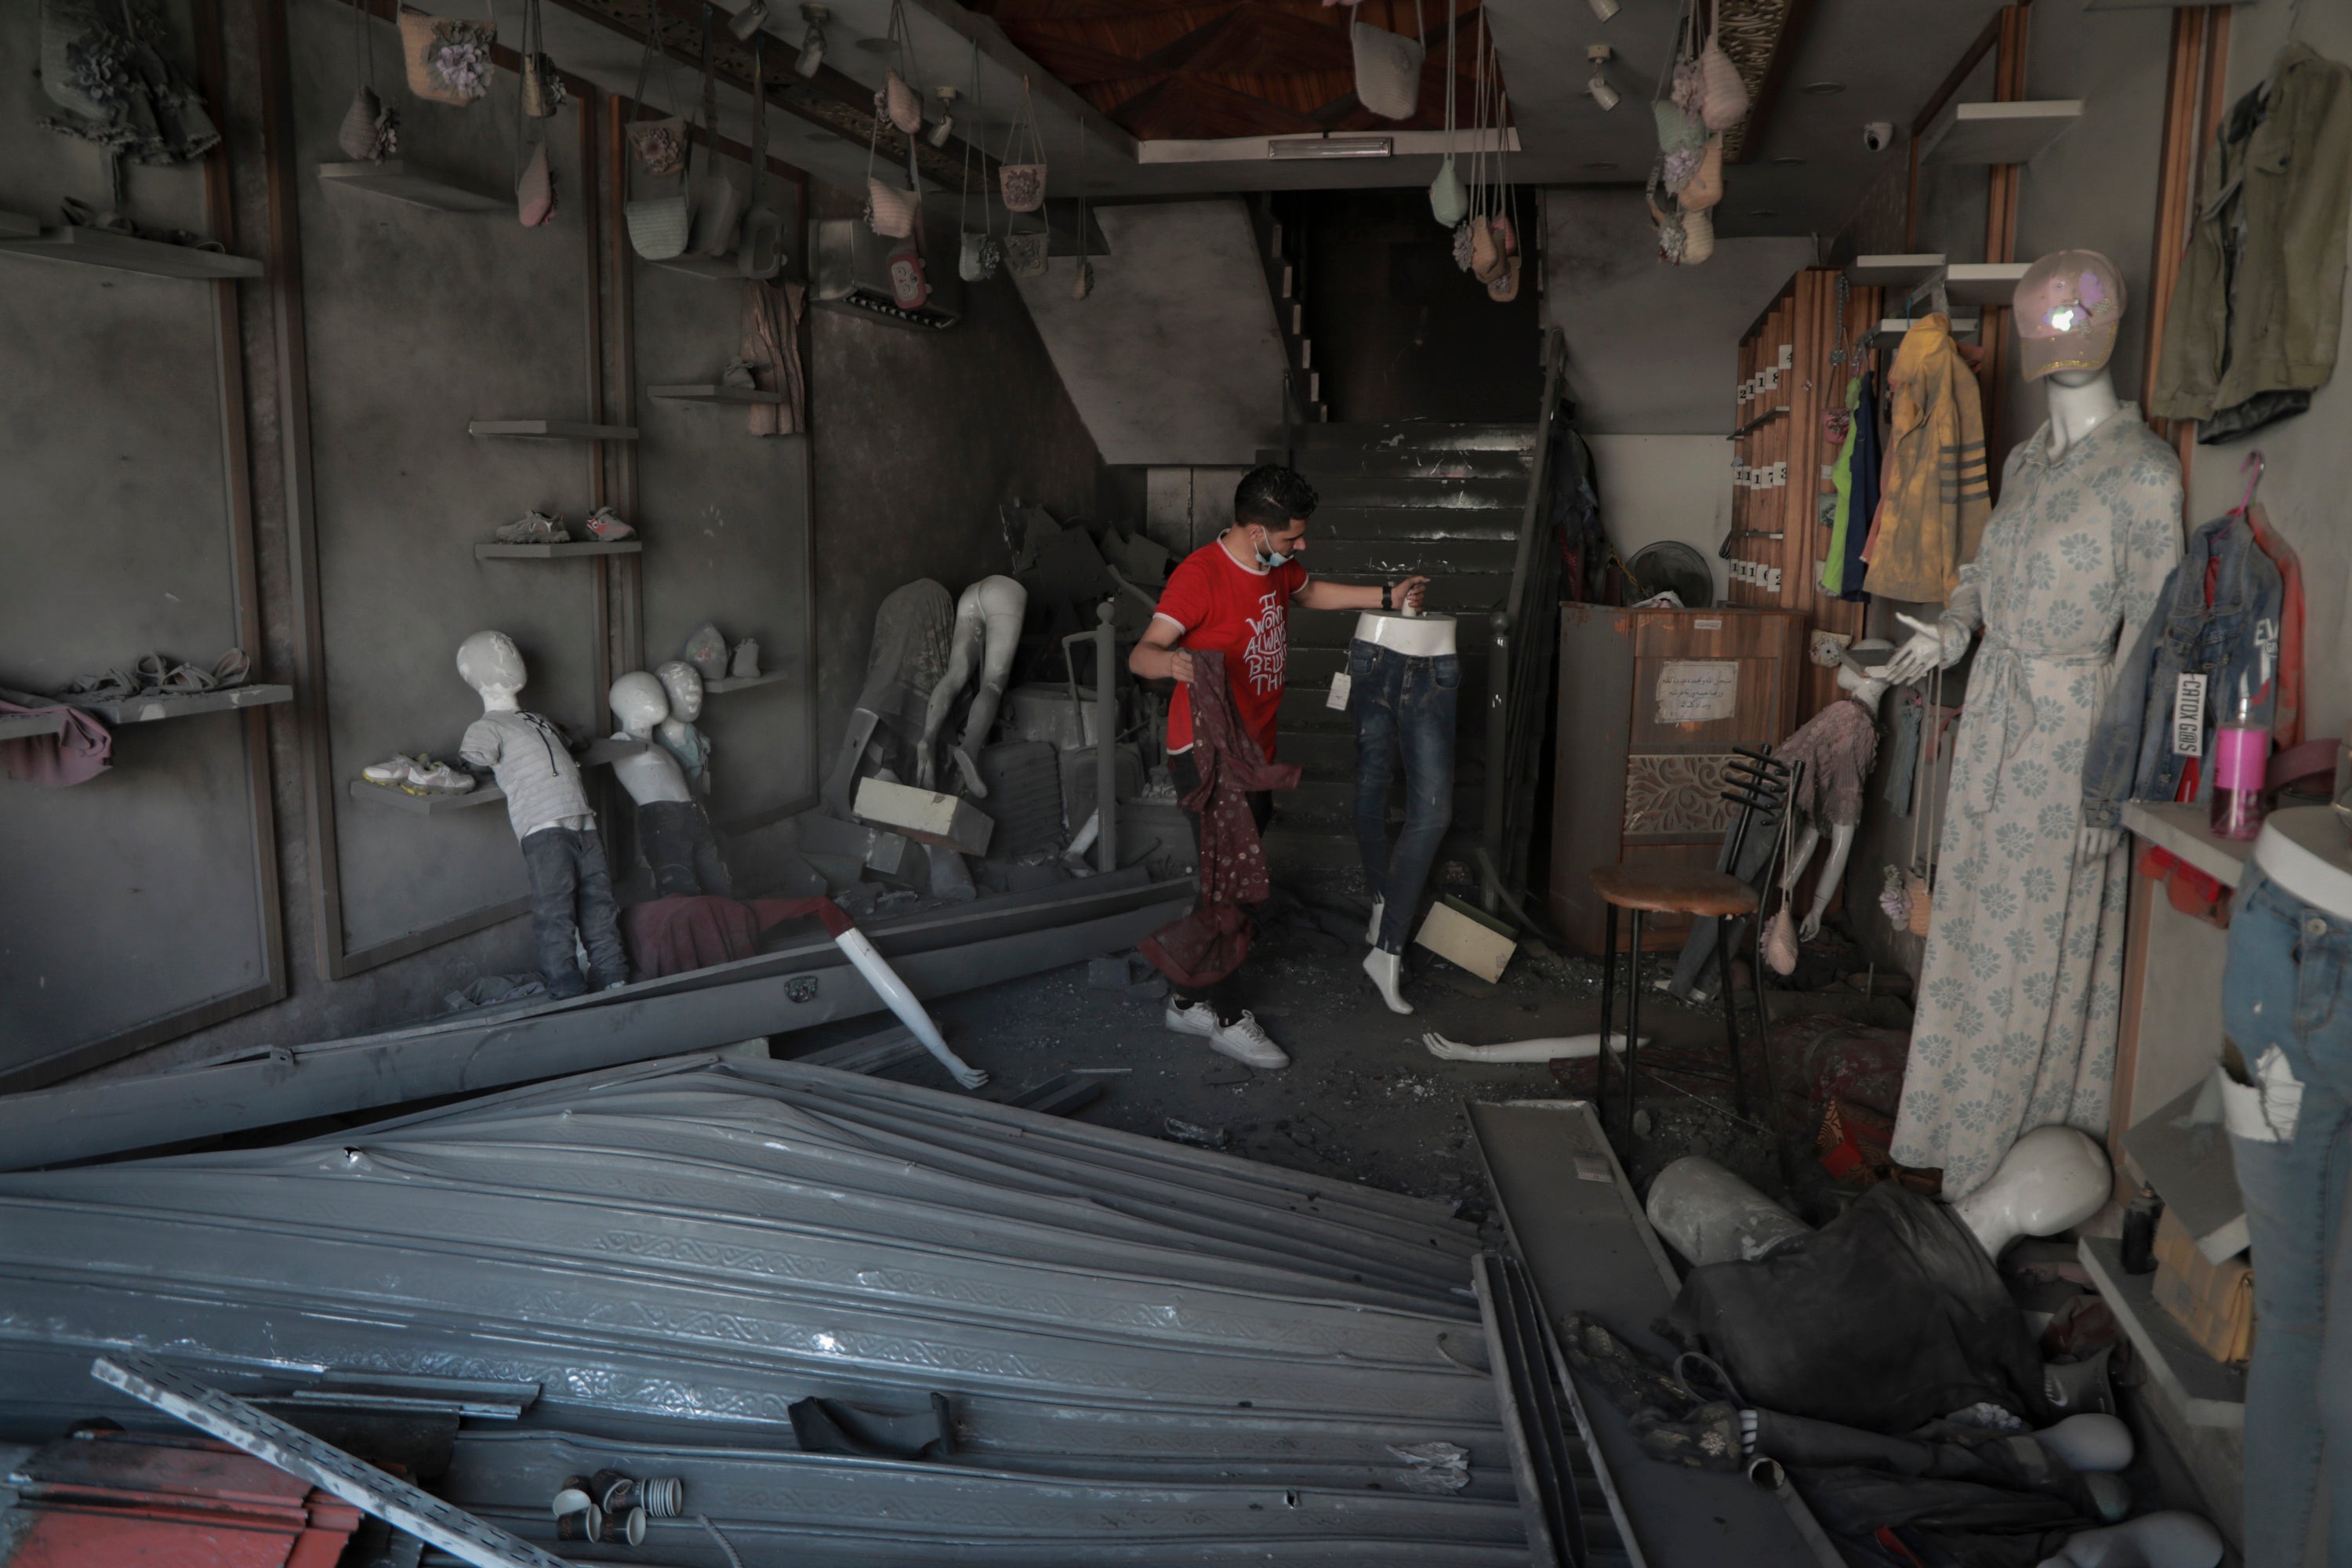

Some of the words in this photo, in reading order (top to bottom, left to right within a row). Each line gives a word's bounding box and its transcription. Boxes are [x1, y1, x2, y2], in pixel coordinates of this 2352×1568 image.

[1259, 590, 1277, 614] IT
[1243, 620, 1287, 659] ALWAYS
[1250, 671, 1285, 696] THI
[2180, 681, 2201, 720] CATOX
